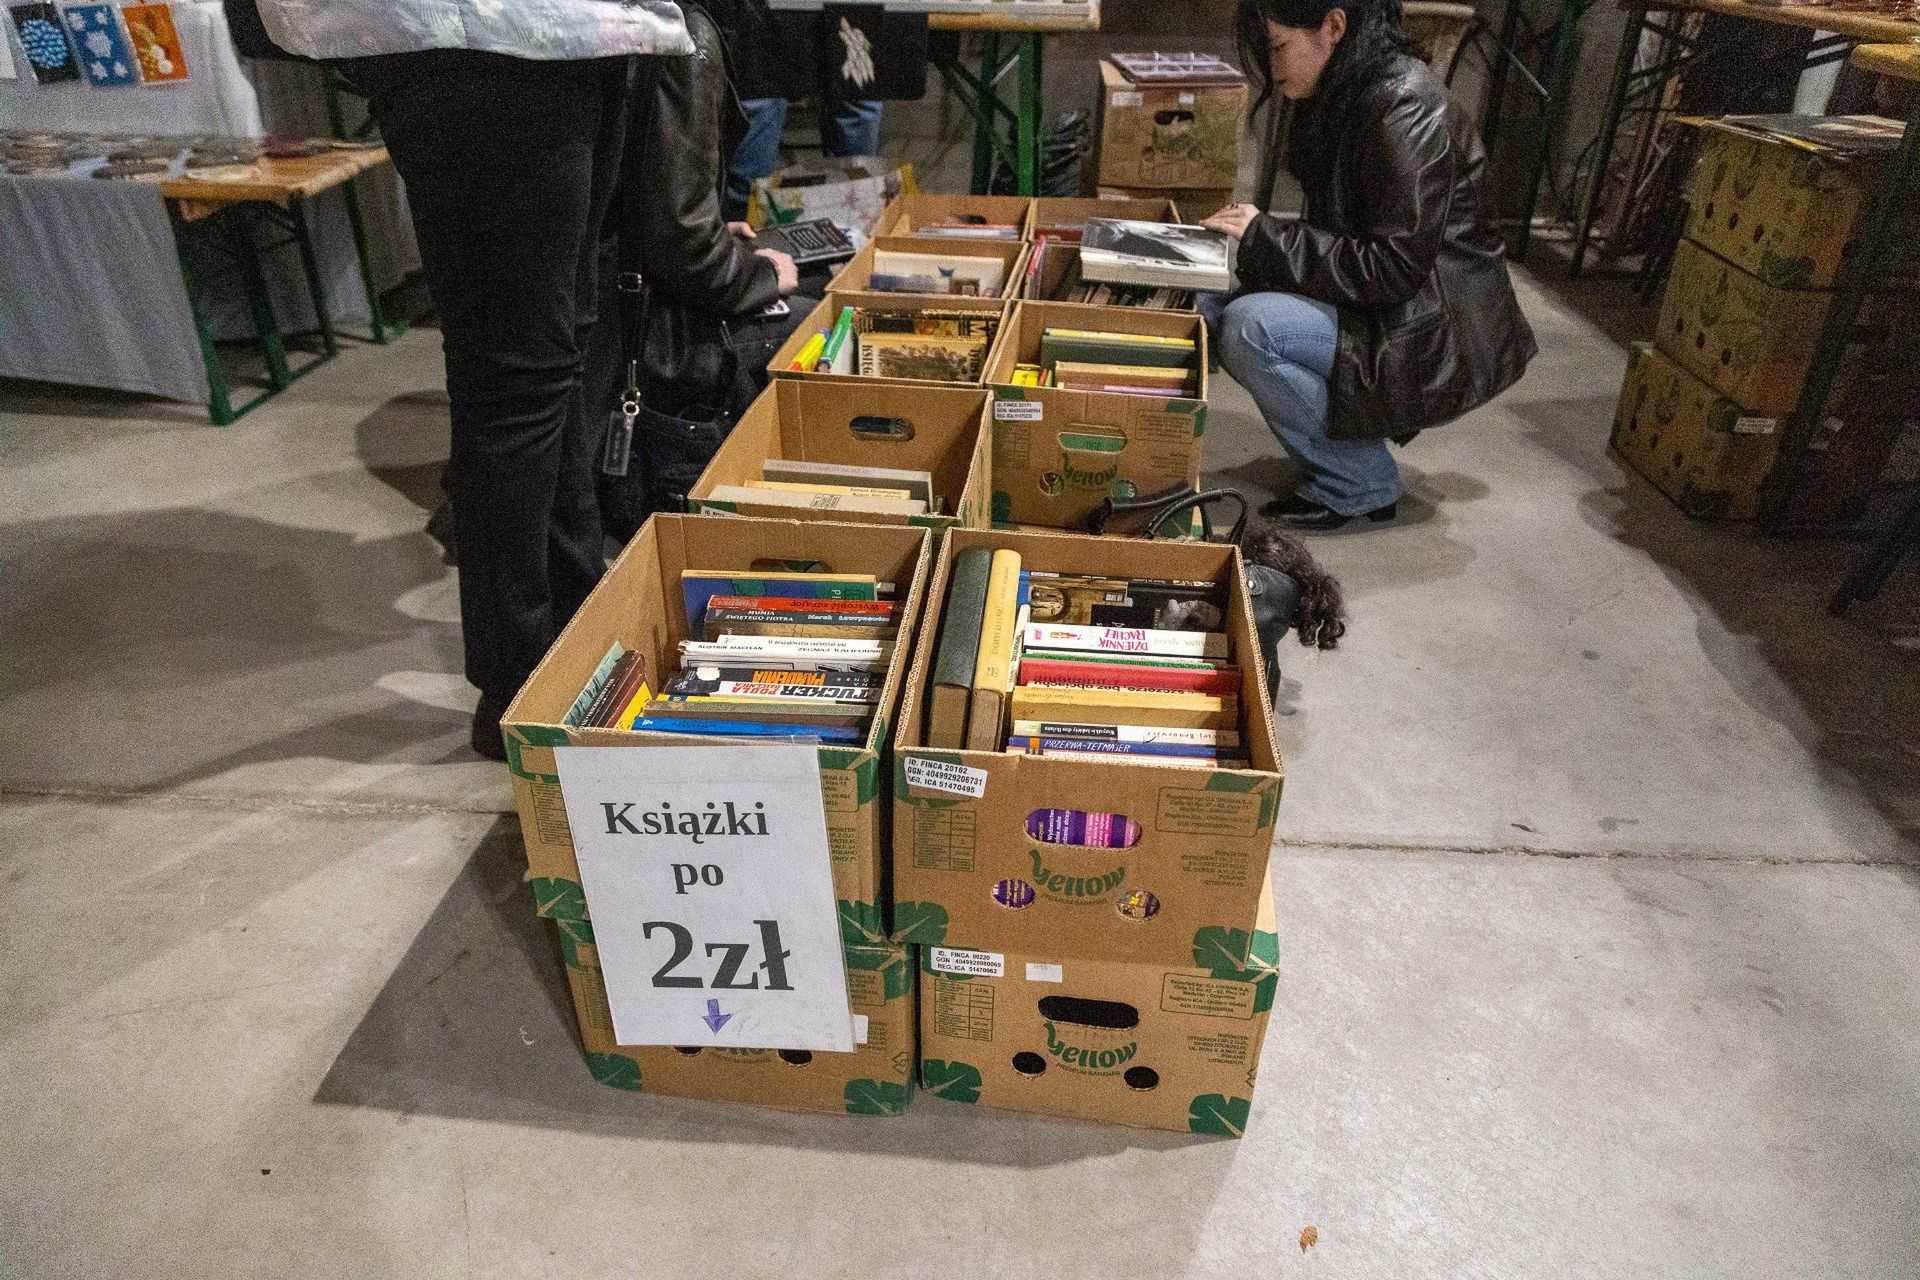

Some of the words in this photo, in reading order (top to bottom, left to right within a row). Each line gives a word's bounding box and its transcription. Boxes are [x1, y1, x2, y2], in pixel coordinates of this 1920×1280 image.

[1105, 628, 1146, 641] RACHEL
[1097, 637, 1148, 652] DZIENNIK
[752, 670, 827, 686] PANDEMIA
[731, 687, 778, 695] PODŁA
[779, 685, 869, 700] TUCKER
[1043, 739, 1131, 754] PRZERWA-TETMAJER
[920, 760, 943, 770] FINCA
[944, 764, 968, 774] 20162
[924, 778, 937, 786] ICA
[938, 781, 975, 794] 51470495
[600, 801, 770, 844] Książki
[671, 863, 724, 894] po
[1028, 848, 1126, 897] yellow
[642, 919, 795, 991] 2zł
[1043, 1022, 1138, 1068] yellow
